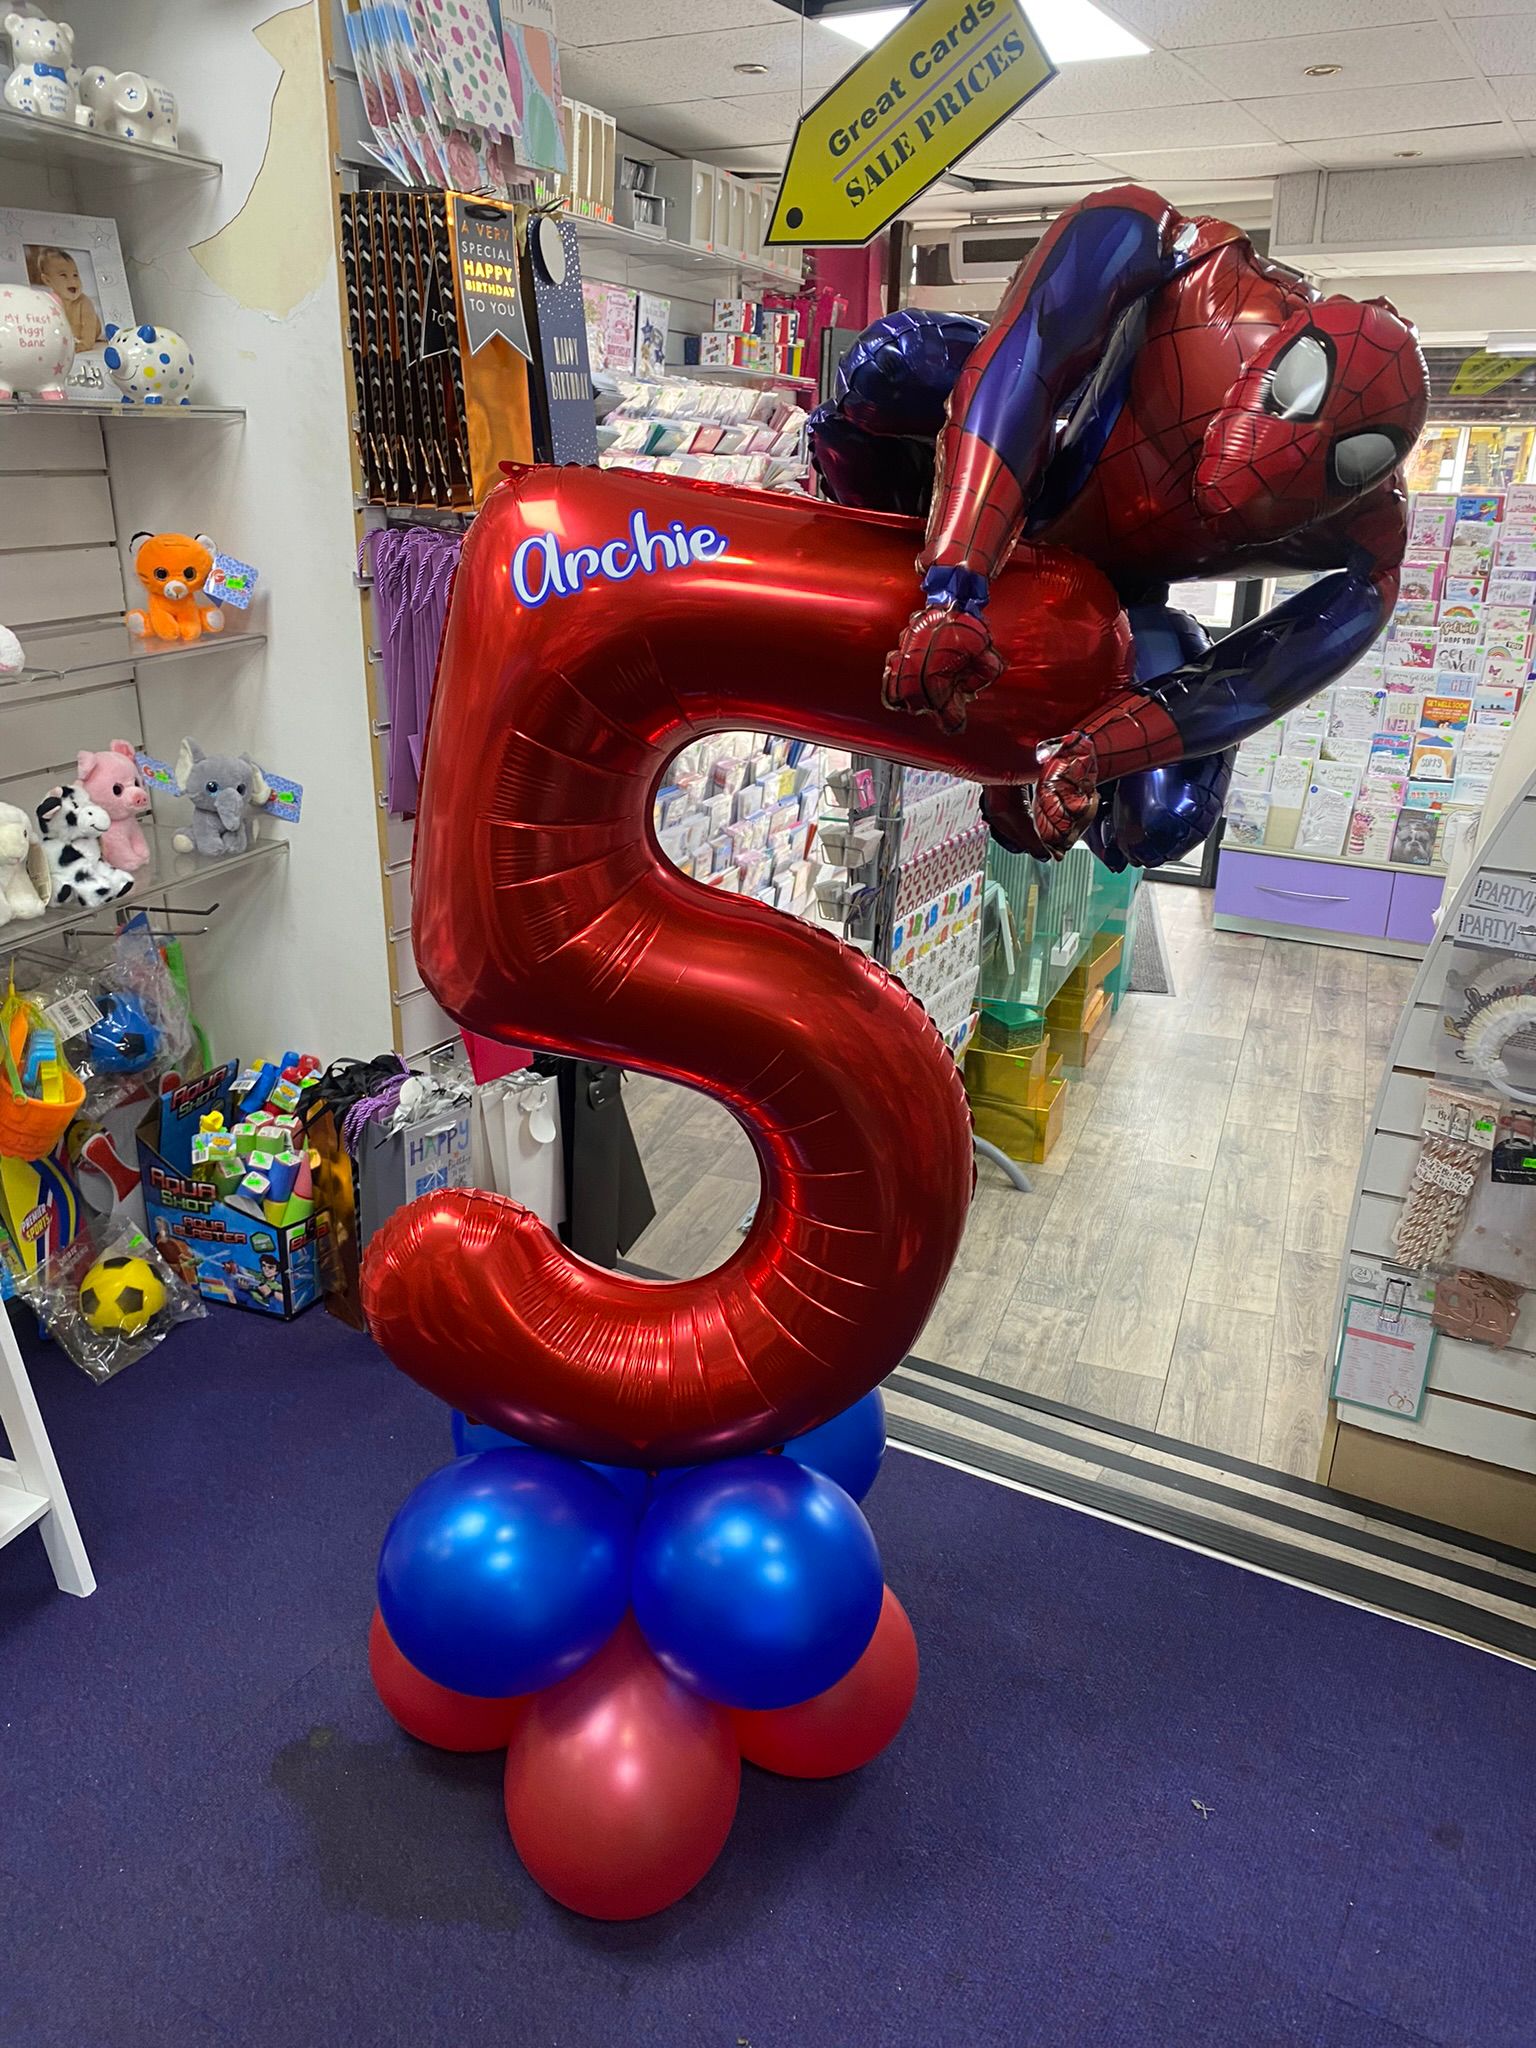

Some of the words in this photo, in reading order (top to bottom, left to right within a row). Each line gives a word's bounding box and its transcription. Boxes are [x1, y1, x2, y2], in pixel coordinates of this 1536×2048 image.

[828, 76, 906, 157] Great
[909, 0, 996, 80] Cards
[845, 132, 916, 207] SALE
[914, 29, 1026, 143] PRICES
[461, 219, 470, 235] A
[475, 222, 510, 242] VERY
[461, 240, 512, 262] SPECIAL
[463, 259, 513, 283] HAPPY
[465, 279, 515, 298] BIRTHDAY
[4, 313, 19, 324] My
[469, 298, 486, 312] TO
[490, 301, 516, 317] YOU
[19, 337, 46, 348] Bank
[511, 510, 728, 607] Archie
[1450, 679, 1473, 693] GET
[151, 1166, 217, 1199] AQUA
[160, 1190, 213, 1213] SHOT
[22, 1203, 47, 1233] PREMIER
[26, 1212, 51, 1241] SPORTS
[183, 1216, 226, 1232] AQUA
[173, 1224, 248, 1245] BLASTER
